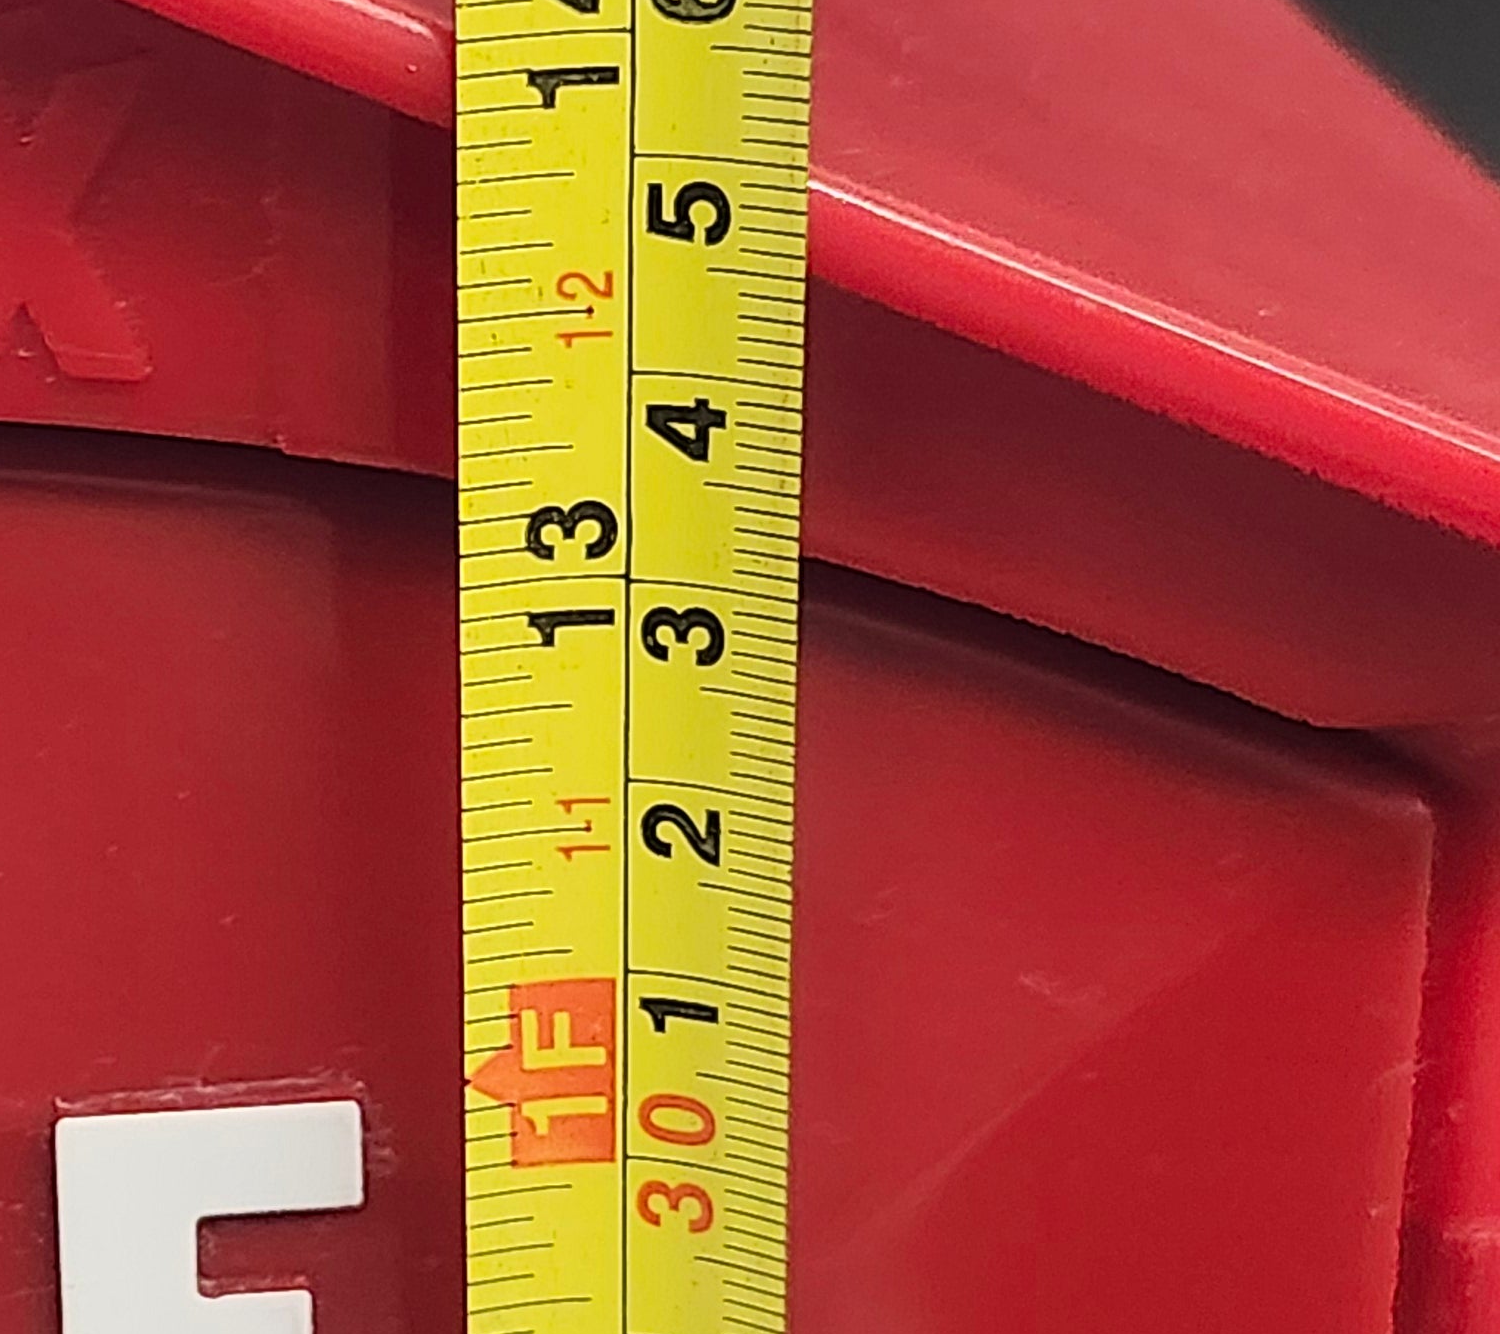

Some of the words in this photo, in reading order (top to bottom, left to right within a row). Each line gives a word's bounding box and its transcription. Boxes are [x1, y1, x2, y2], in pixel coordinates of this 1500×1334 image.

[647, 181, 732, 245] 5
[646, 398, 727, 462] 4
[525, 500, 618, 647] 13
[641, 606, 725, 667] 3
[641, 803, 721, 867] 2
[639, 996, 719, 1033] 1
[520, 1008, 607, 1137] 1F
